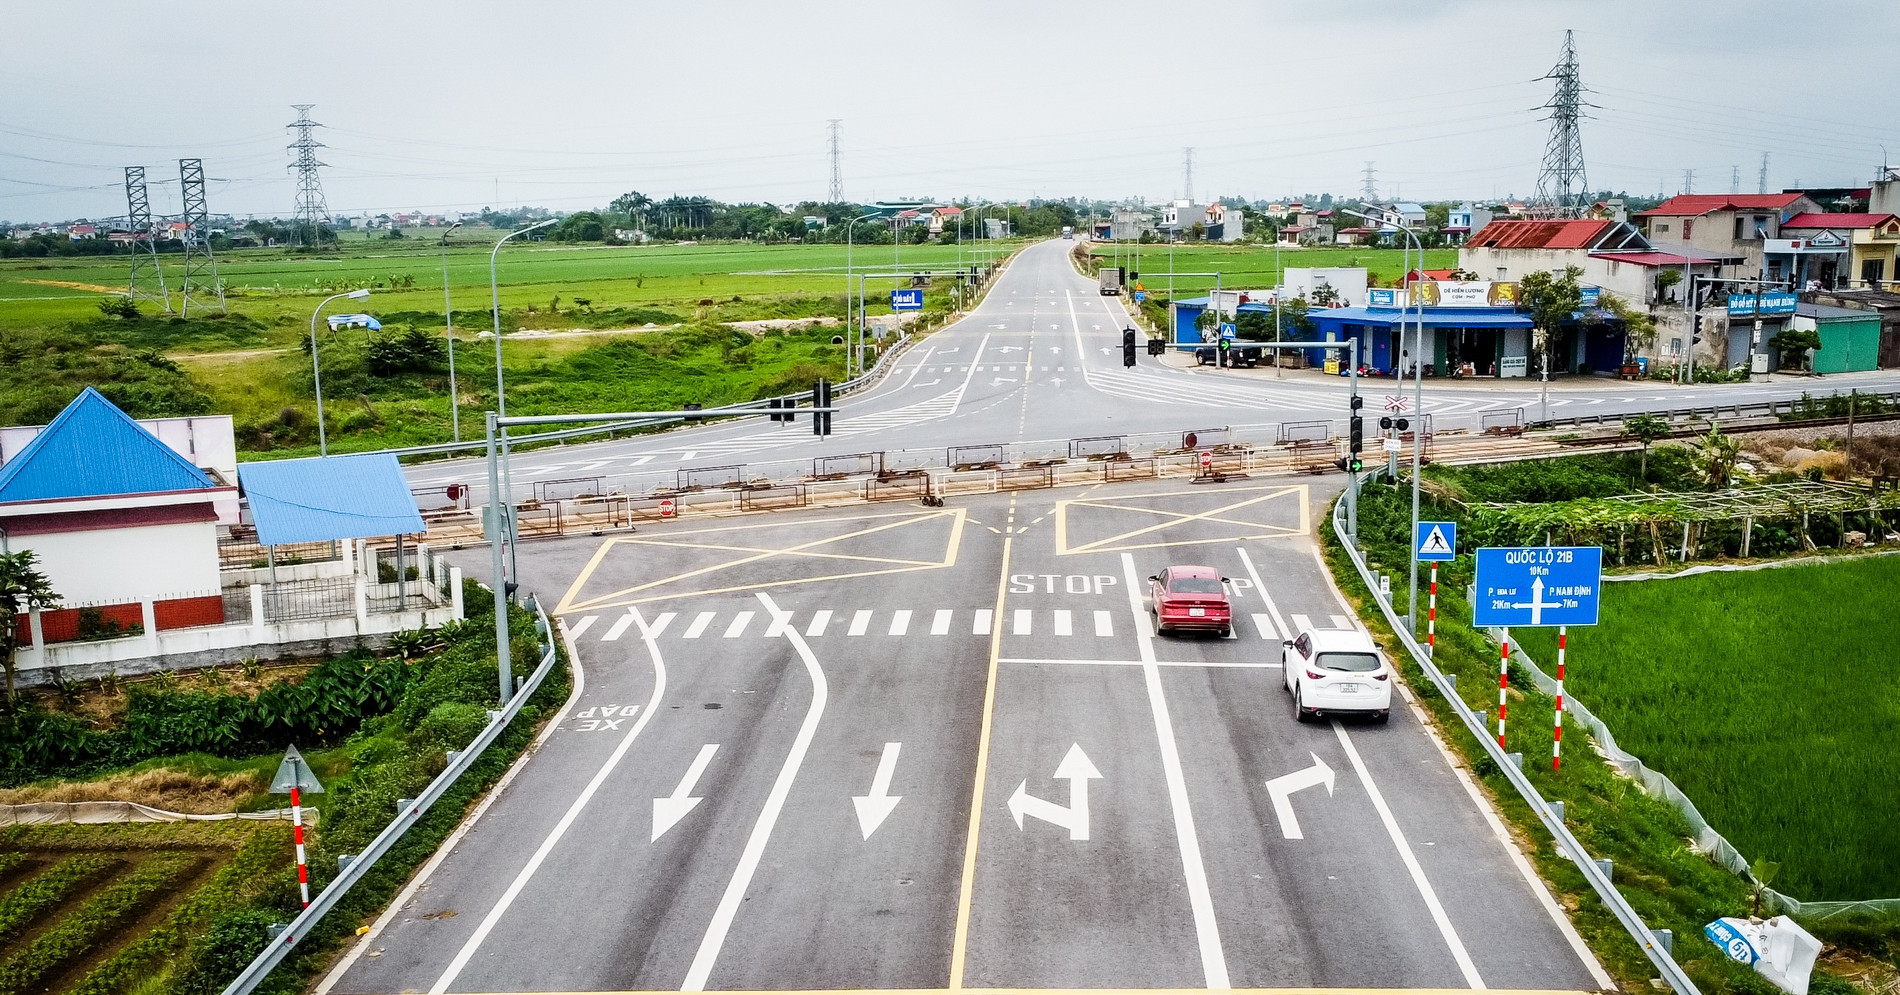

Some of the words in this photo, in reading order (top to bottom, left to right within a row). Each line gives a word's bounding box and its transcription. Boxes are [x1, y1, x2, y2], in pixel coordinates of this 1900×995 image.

[659, 504, 674, 512] STOP
[1506, 549, 1536, 564] QUỐC
[1539, 549, 1553, 565] LỘ
[1557, 551, 1573, 563] 21B
[1529, 566, 1549, 575] 10Km
[1010, 574, 1117, 594] STOP
[1509, 587, 1517, 595] LƯ
[1556, 586, 1573, 596] NAM
[1574, 585, 1591, 597] ĐỊNH
[1492, 600, 1511, 609] 21Km
[1562, 599, 1578, 609] 7Km
[576, 703, 640, 718] ĐẠP
[576, 719, 626, 731] XE
